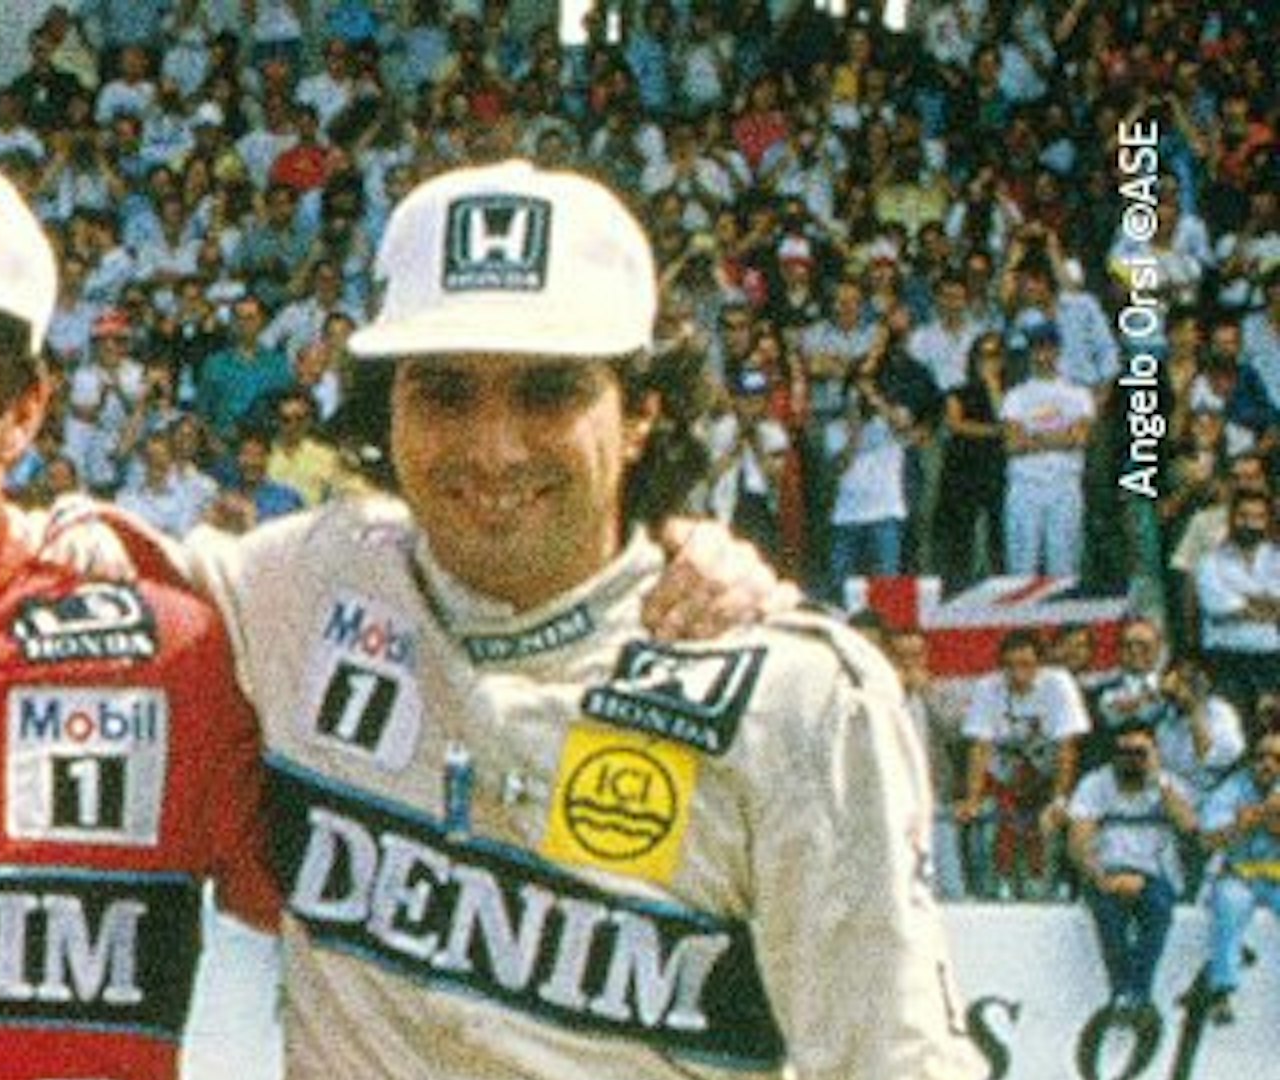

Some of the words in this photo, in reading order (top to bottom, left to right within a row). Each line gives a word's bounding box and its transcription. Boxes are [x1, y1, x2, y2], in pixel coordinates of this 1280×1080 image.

[18, 698, 156, 742] Mobil
[337, 673, 378, 740] 1
[587, 692, 724, 752] HONDA
[66, 758, 100, 825] 1
[594, 759, 652, 802] ICI
[288, 805, 730, 1030] DENIM
